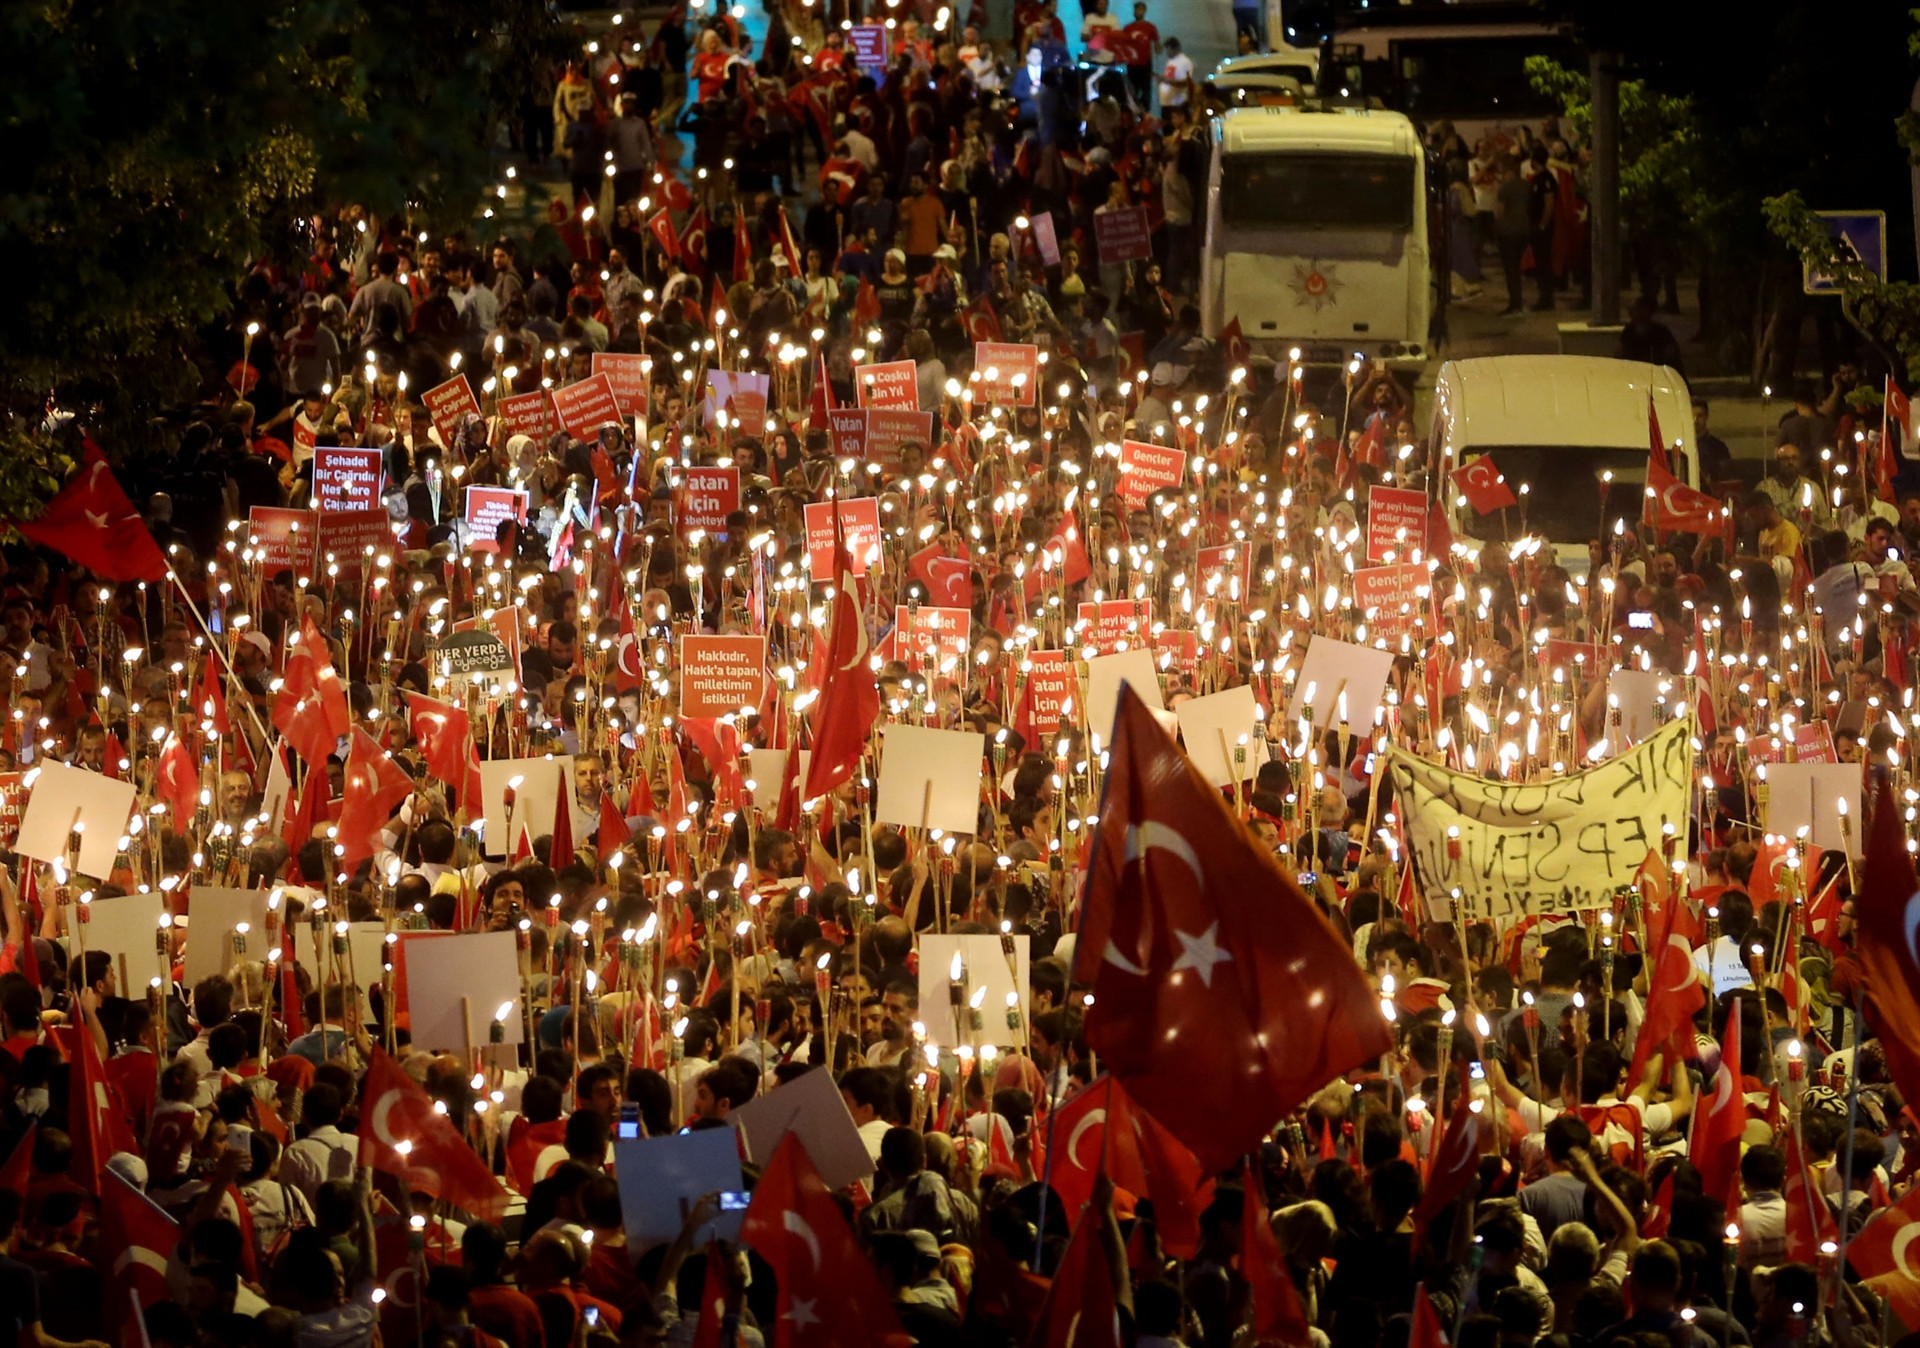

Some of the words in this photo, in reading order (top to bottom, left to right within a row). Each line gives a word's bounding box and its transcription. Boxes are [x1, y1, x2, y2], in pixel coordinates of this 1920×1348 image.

[508, 399, 547, 415] Şehade
[833, 417, 863, 432] Vatan
[325, 454, 369, 467] Şehadet
[1133, 449, 1173, 466] Gençler
[316, 468, 333, 480] Bir
[334, 469, 376, 483] Çağrıdır
[1130, 466, 1176, 483] eydanda
[687, 475, 729, 491] atan
[845, 514, 857, 523] bu
[436, 648, 461, 661] HER
[464, 643, 504, 658] YERDE
[697, 650, 749, 663] Hakkıdır,
[685, 664, 724, 676] Hakk'a
[726, 665, 761, 678] tapan,
[693, 679, 752, 690] milletimin
[1033, 679, 1064, 692] atan
[702, 693, 746, 704] istiklal!
